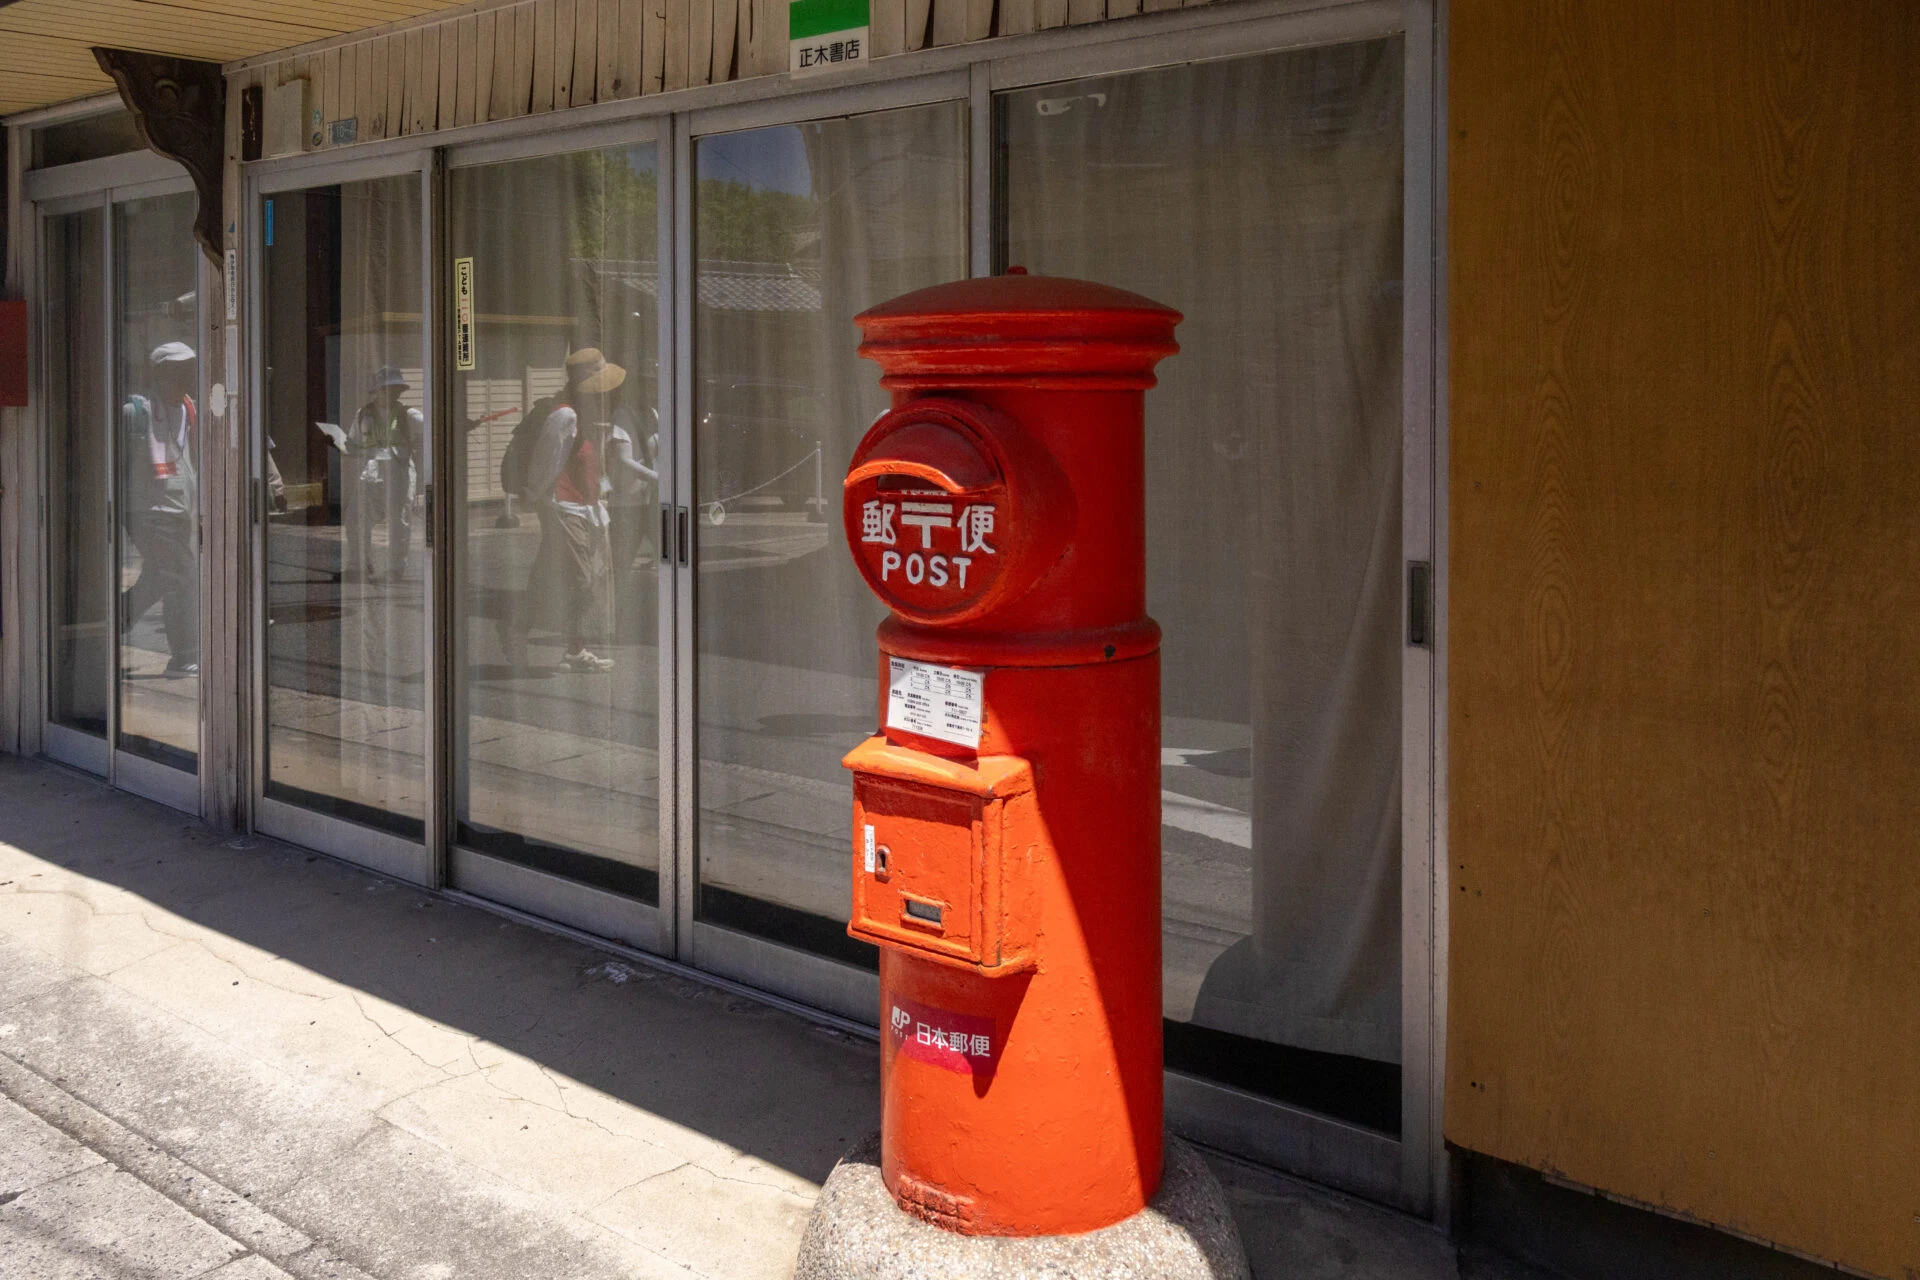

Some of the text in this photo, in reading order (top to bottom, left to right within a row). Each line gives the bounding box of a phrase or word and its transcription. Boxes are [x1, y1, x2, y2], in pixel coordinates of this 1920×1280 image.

[799, 39, 860, 68] 正木書店
[882, 550, 972, 589] POST
[916, 1021, 991, 1058] 日本郵便
